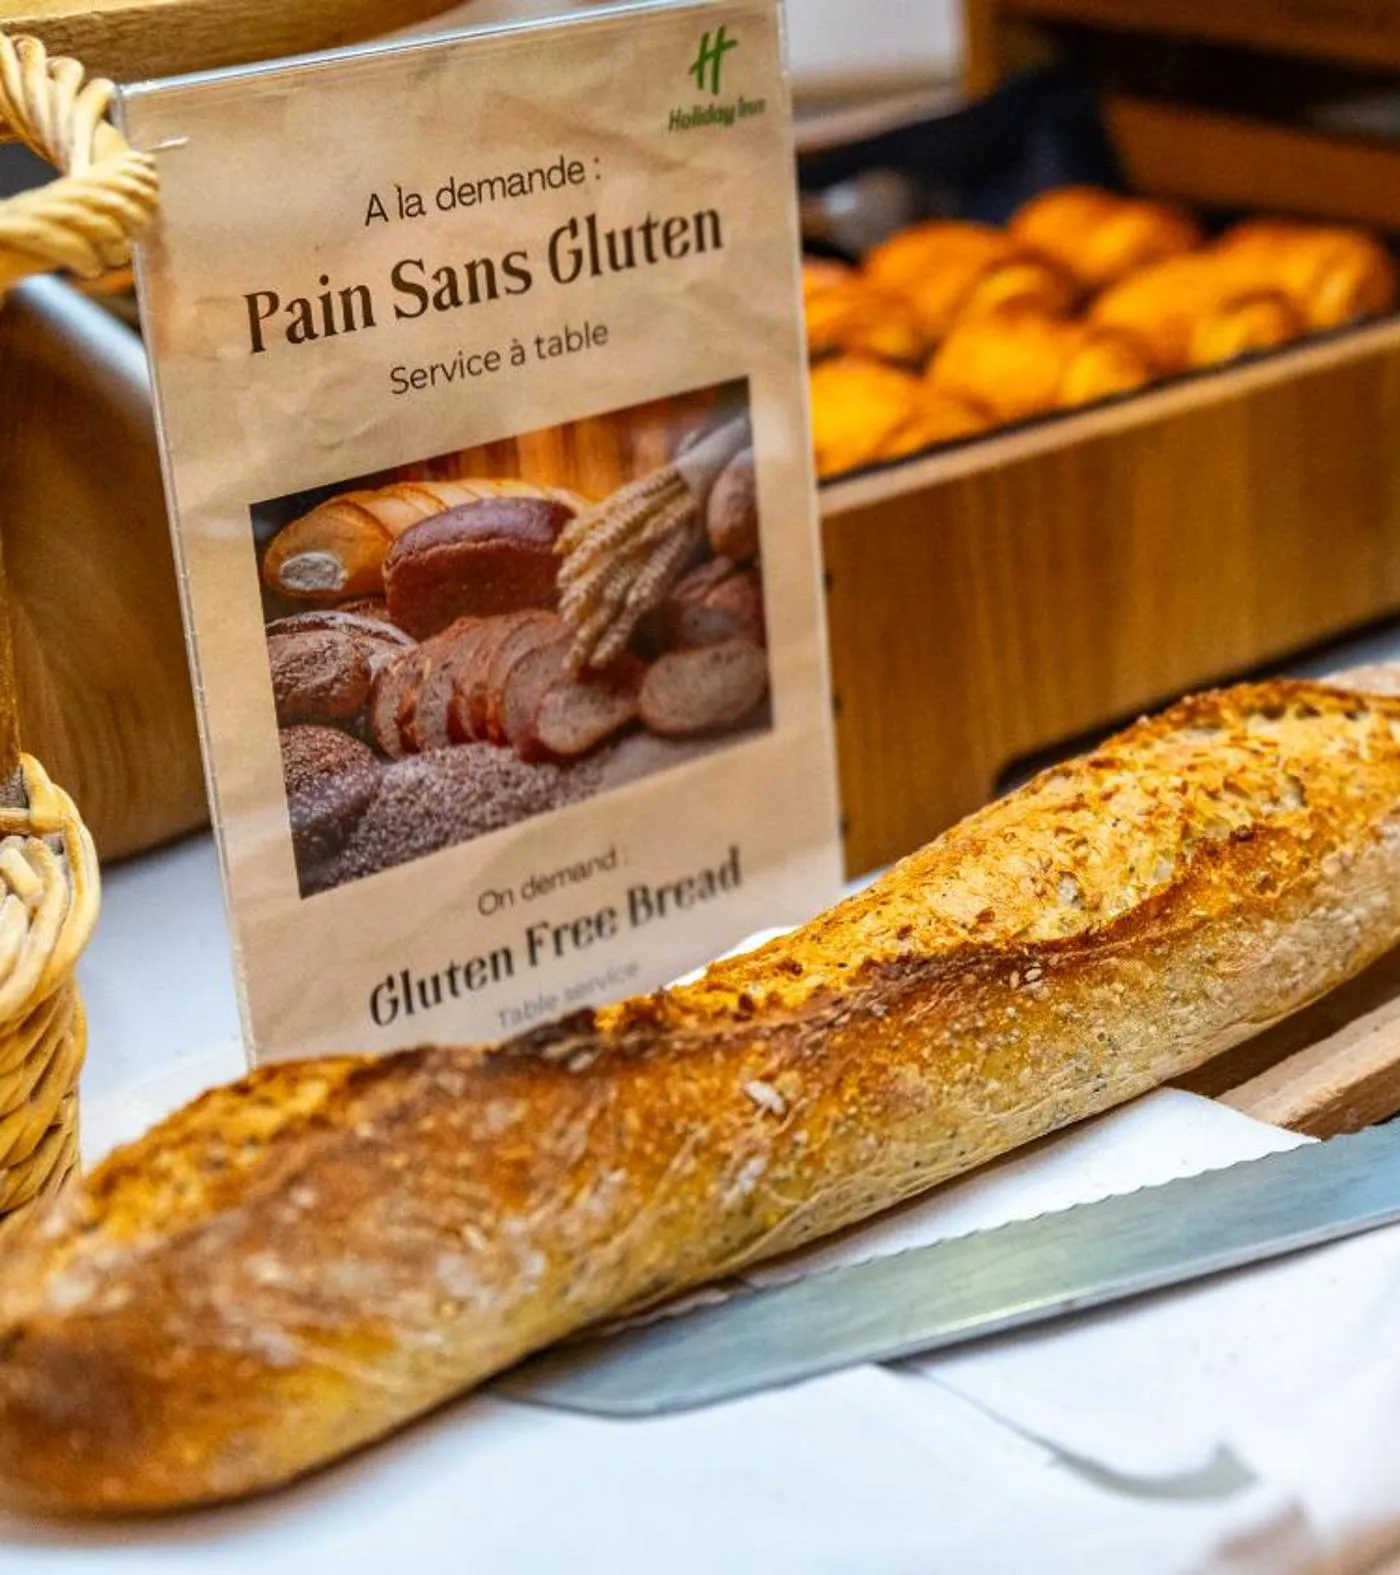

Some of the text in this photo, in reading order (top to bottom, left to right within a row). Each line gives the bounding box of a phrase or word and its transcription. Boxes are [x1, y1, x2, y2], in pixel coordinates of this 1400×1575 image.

[668, 95, 767, 131] Holiday Inn
[364, 192, 389, 226] A
[397, 185, 425, 220] la
[435, 155, 585, 213] demande
[244, 207, 723, 355] Pain Sans Gluten
[389, 320, 609, 395] Service à table
[478, 888, 514, 916] On
[521, 845, 616, 900] demand
[369, 845, 743, 1027] Gluten Free Bread
